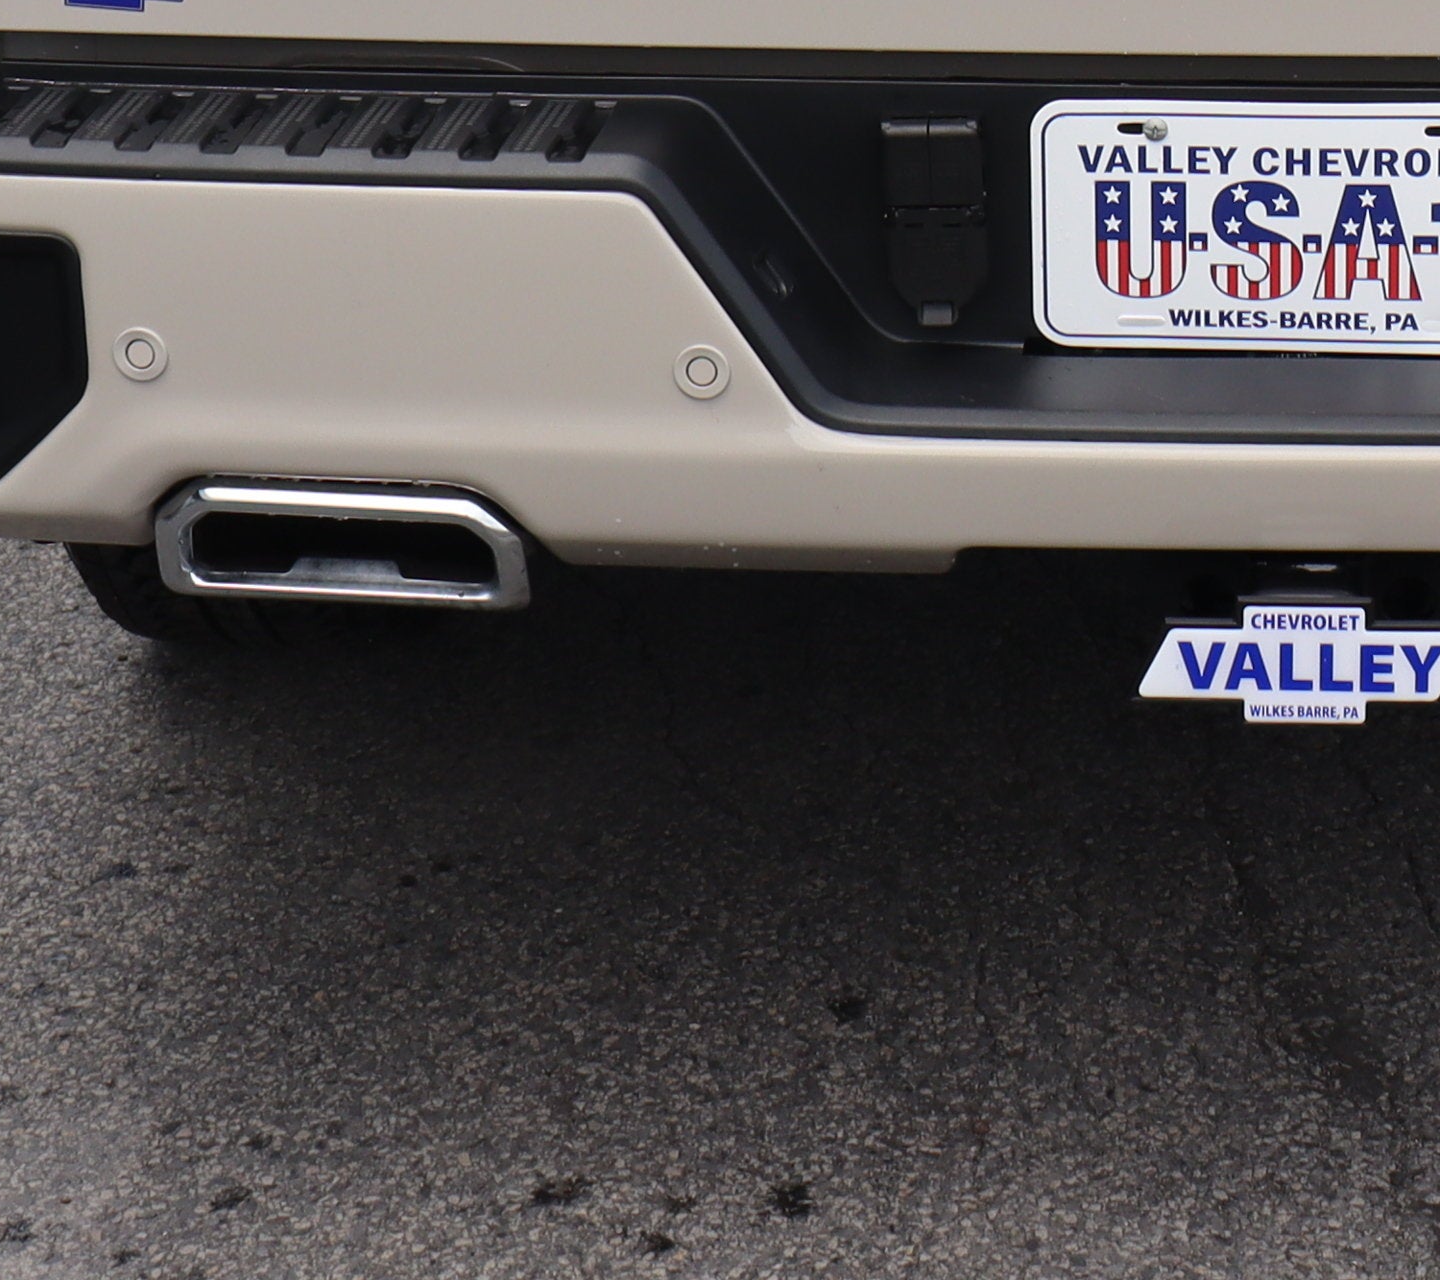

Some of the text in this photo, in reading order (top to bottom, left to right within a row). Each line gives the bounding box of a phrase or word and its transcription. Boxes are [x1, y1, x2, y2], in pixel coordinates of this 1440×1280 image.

[1077, 144, 1238, 175] VALLEY
[1168, 308, 1420, 335] WILKES-BARRE, PA
[1250, 613, 1360, 632] CHEVROLET
[1249, 704, 1359, 720] WILKES BARRE, PA
